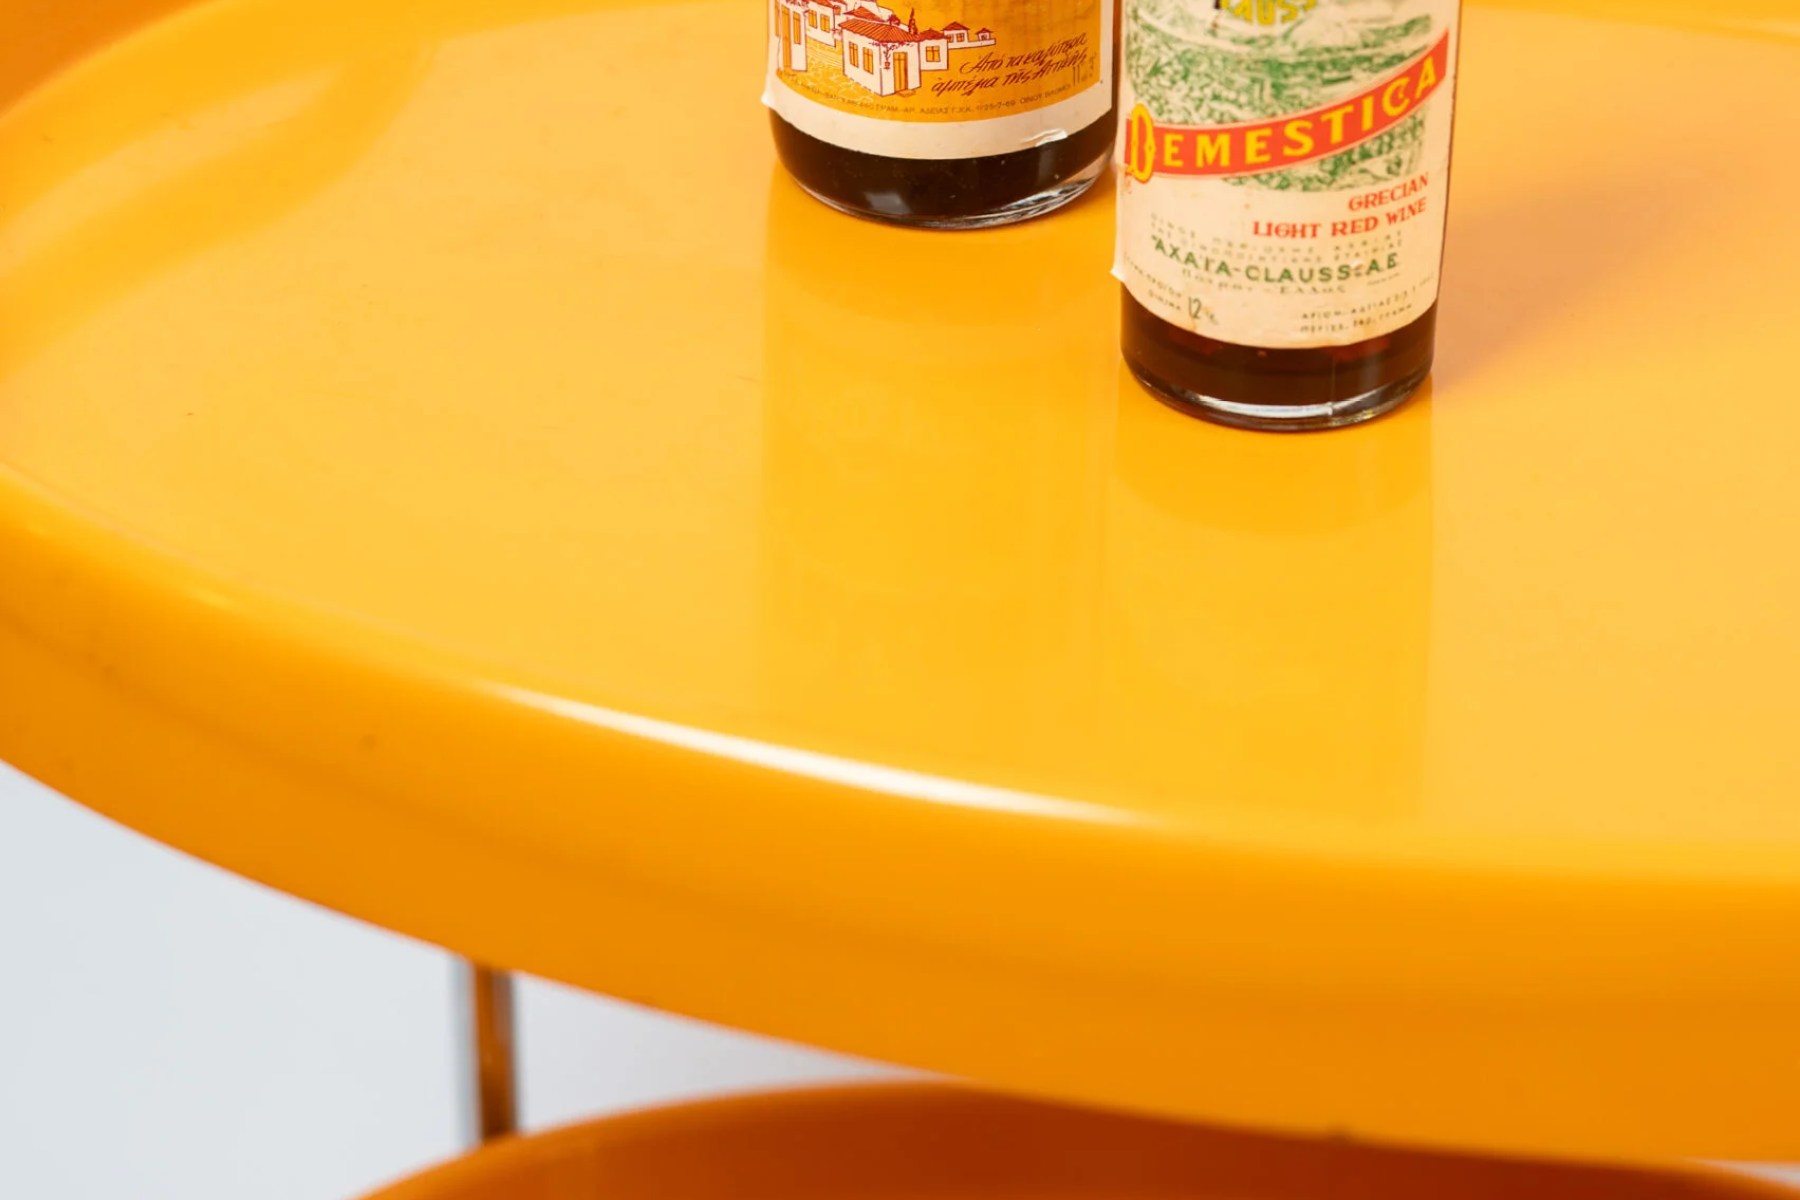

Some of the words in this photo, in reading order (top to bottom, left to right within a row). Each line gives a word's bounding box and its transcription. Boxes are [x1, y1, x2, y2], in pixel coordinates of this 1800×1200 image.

[1127, 55, 1439, 184] DEMESTICA
[1347, 171, 1430, 213] GRECIAN
[1252, 220, 1322, 239] LIGHT
[1330, 215, 1379, 238] RED
[1386, 196, 1428, 228] WINE
